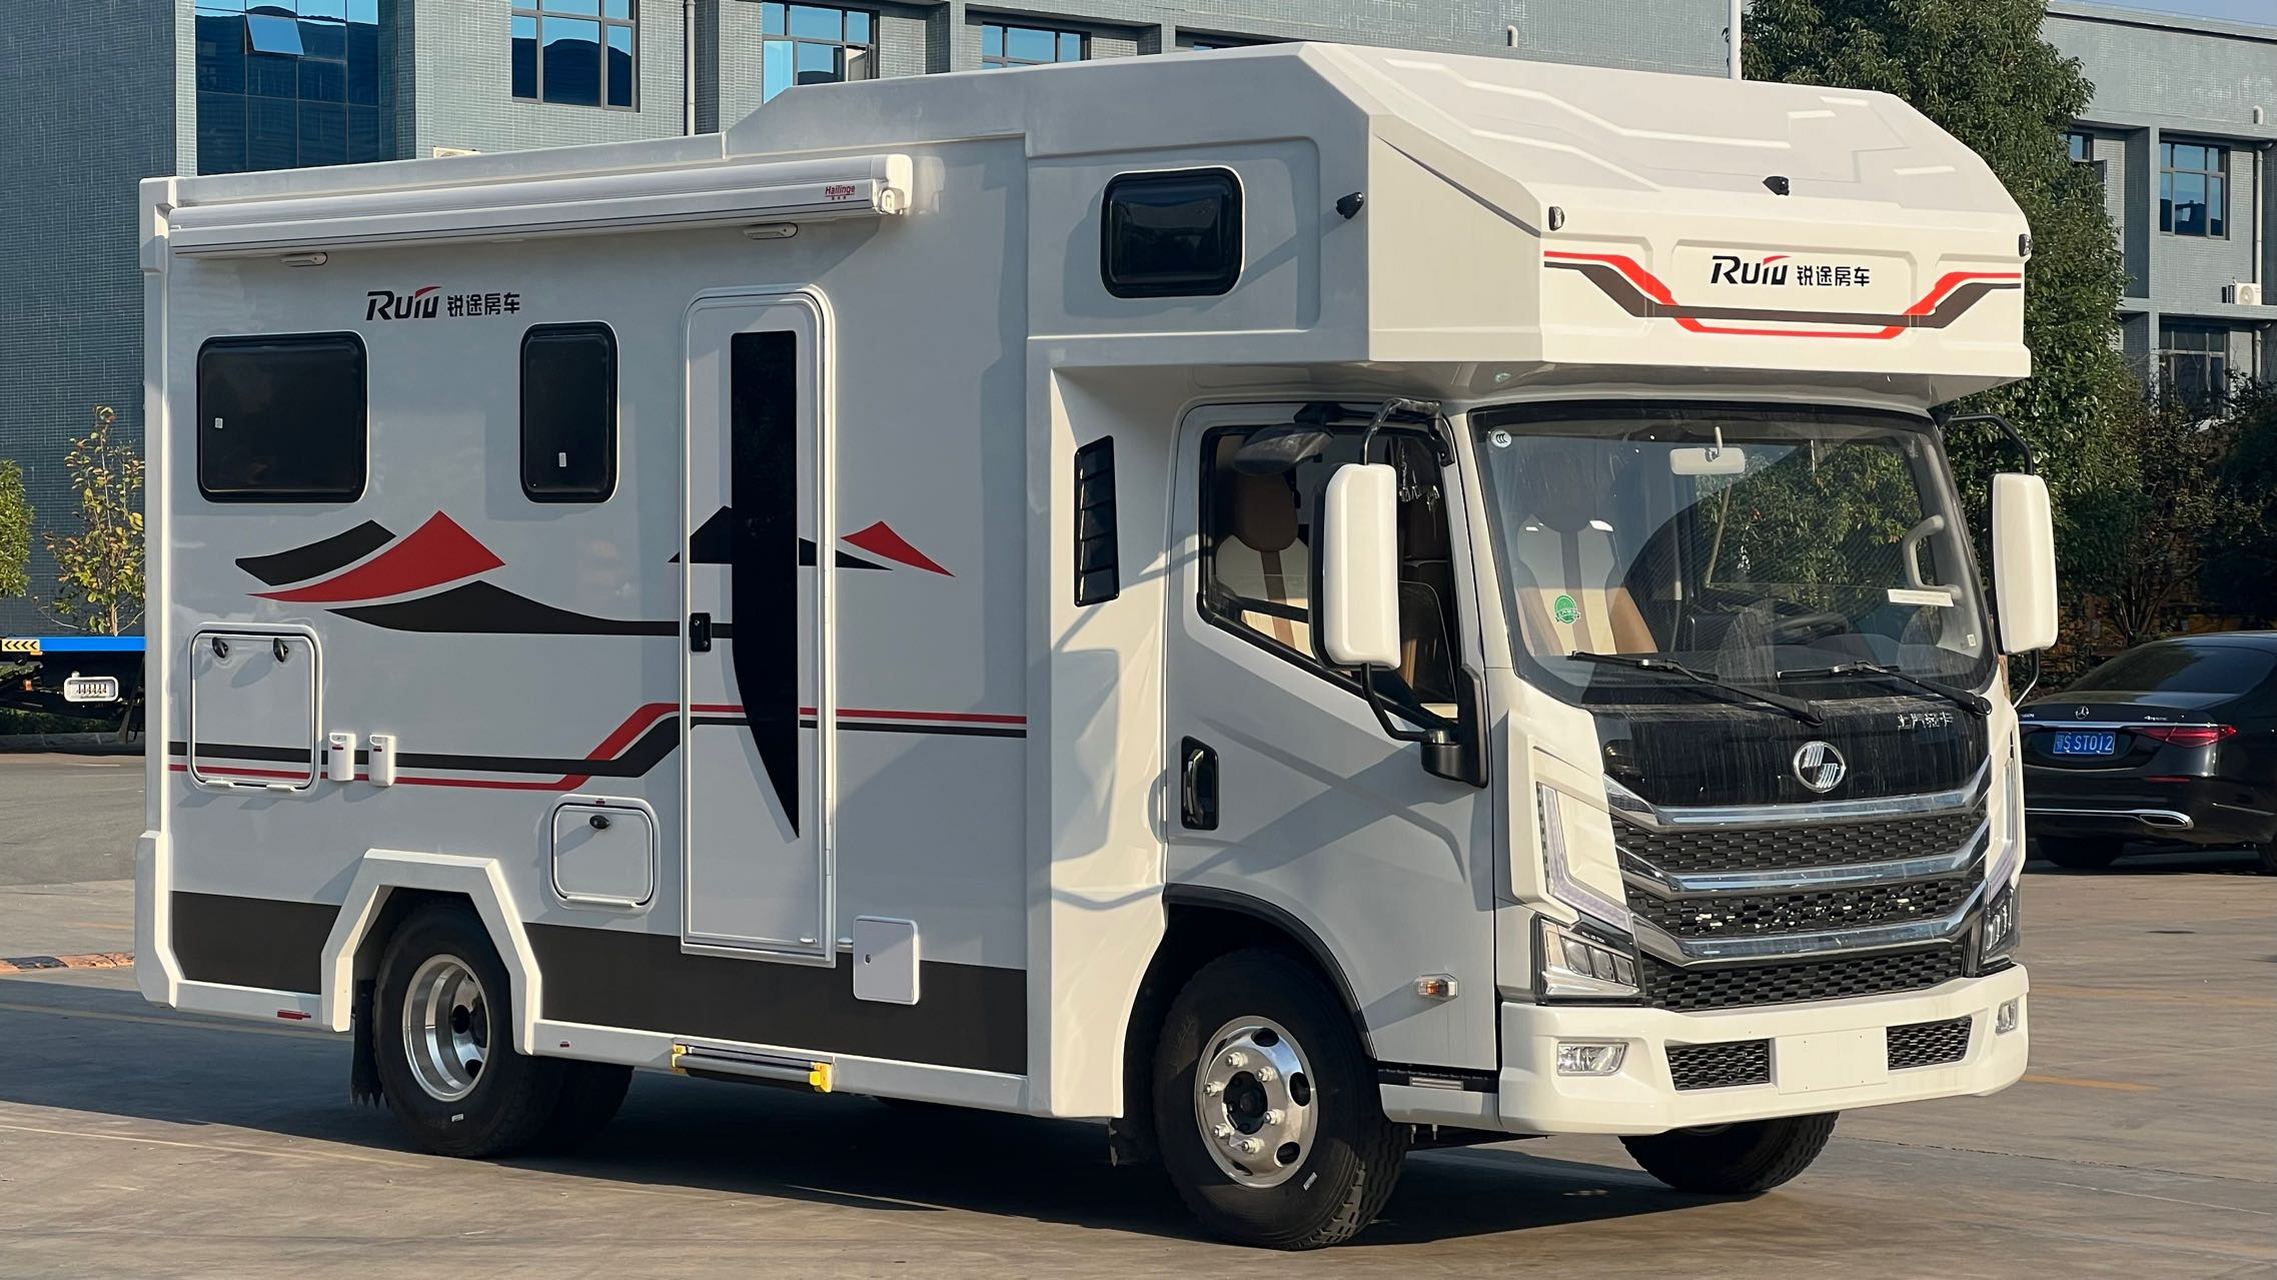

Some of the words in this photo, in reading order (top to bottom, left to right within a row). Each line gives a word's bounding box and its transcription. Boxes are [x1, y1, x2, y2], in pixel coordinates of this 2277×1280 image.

[1797, 265, 1870, 287] 锐途房车
[447, 292, 520, 317] 锐途房车
